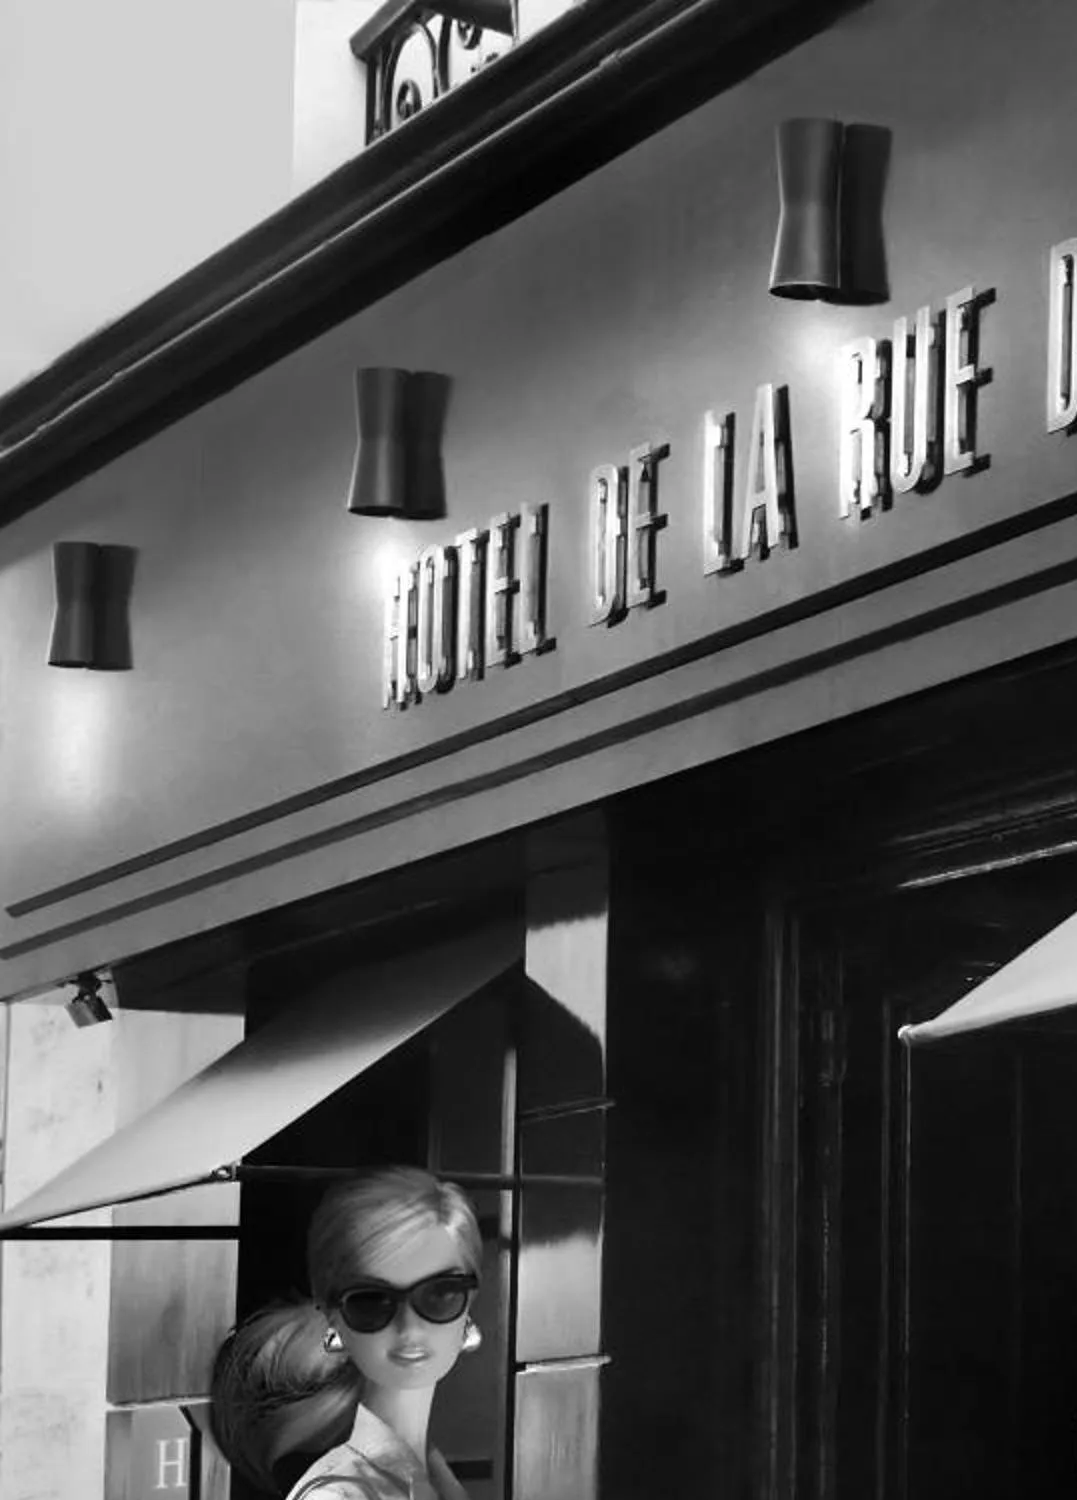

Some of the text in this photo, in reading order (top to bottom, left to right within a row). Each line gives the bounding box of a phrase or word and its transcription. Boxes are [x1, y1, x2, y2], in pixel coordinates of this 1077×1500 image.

[382, 501, 543, 711] HOTEL
[588, 440, 655, 627] DE
[702, 382, 784, 578] LA
[838, 285, 980, 520] RUE
[154, 1437, 188, 1489] H
